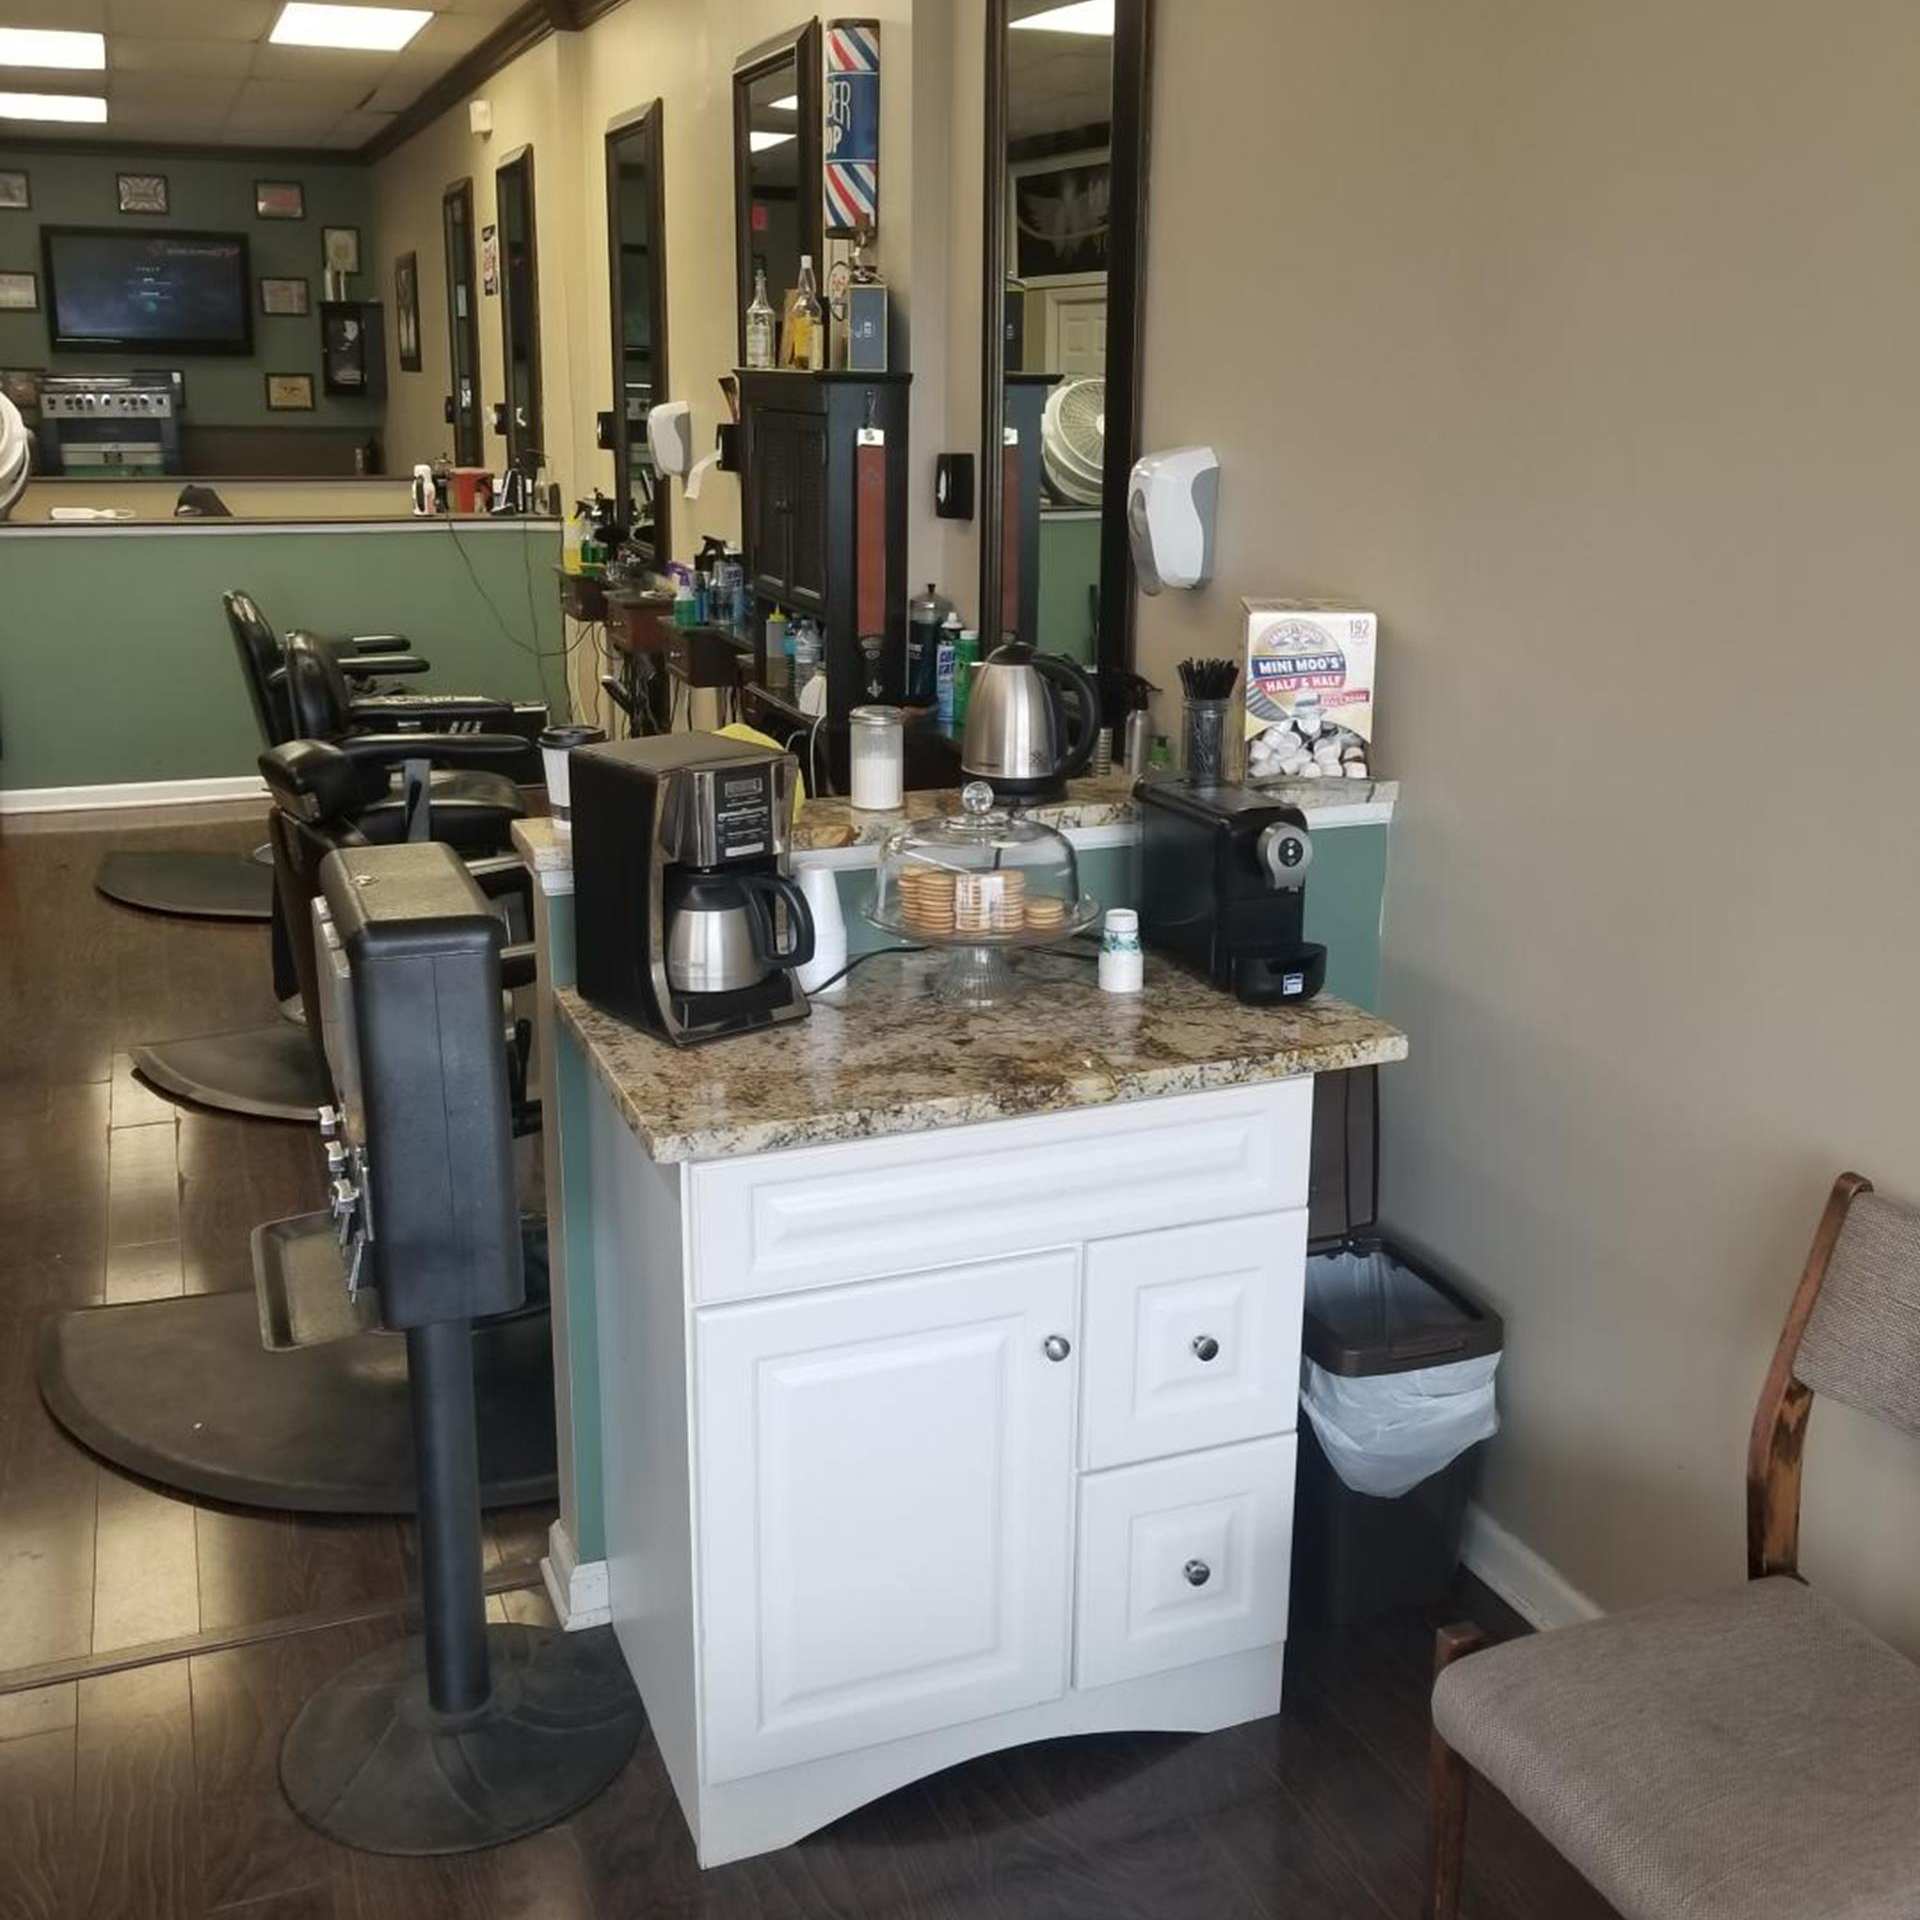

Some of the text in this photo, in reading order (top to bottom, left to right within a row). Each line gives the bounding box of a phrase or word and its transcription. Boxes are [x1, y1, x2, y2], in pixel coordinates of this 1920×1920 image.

[1349, 619, 1370, 635] 192
[1259, 656, 1340, 675] MINI MOO'S
[1266, 678, 1298, 692] HALF
[1312, 675, 1341, 689] HALF
